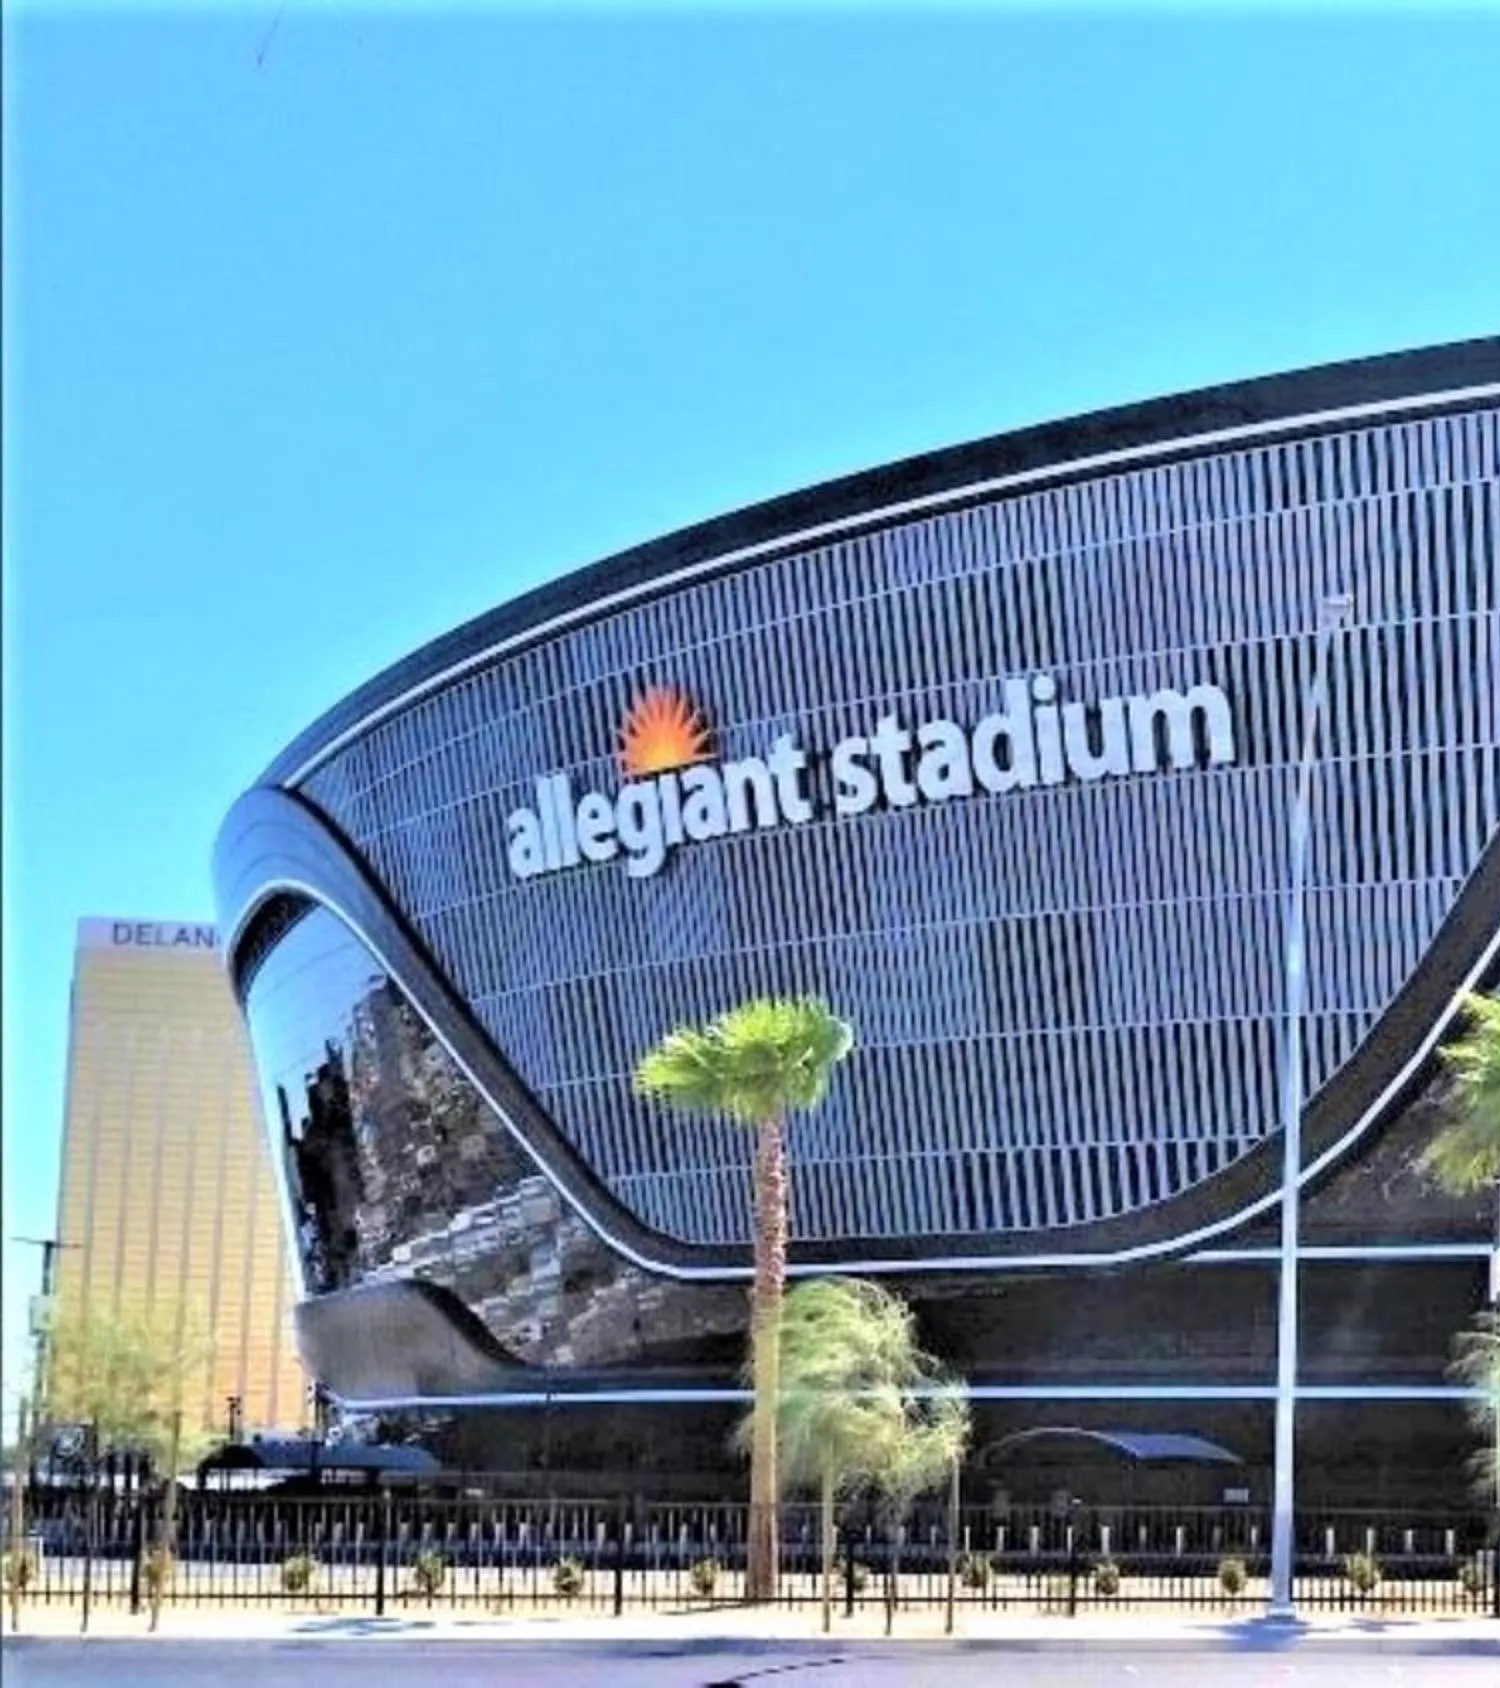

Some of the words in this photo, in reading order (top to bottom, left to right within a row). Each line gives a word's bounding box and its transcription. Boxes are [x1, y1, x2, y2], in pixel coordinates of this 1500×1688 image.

[507, 734, 813, 878] allegiant
[832, 674, 1236, 817] stadium
[112, 921, 221, 948] DELAN
